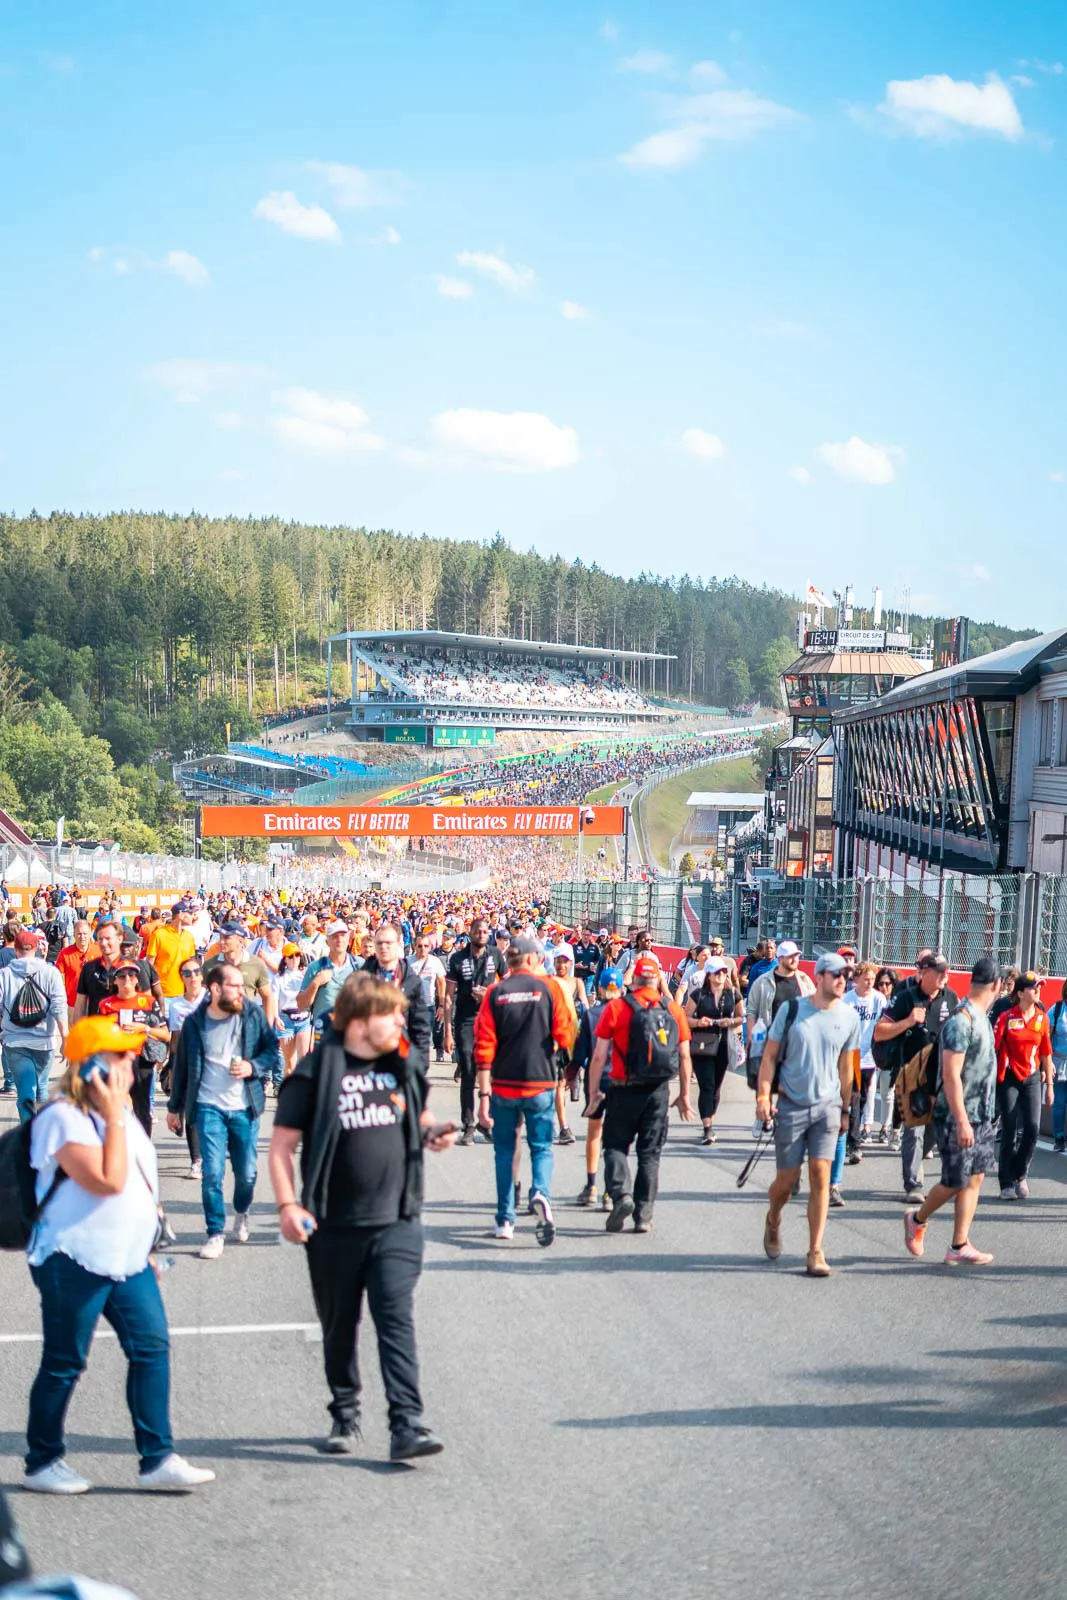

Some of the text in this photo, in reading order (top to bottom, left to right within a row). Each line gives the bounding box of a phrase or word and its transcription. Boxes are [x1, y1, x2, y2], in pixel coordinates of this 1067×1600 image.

[810, 632, 836, 644] 16:44
[264, 813, 410, 830] Emirates FLY BETTER
[432, 813, 574, 830] Emirates FLY BETTER
